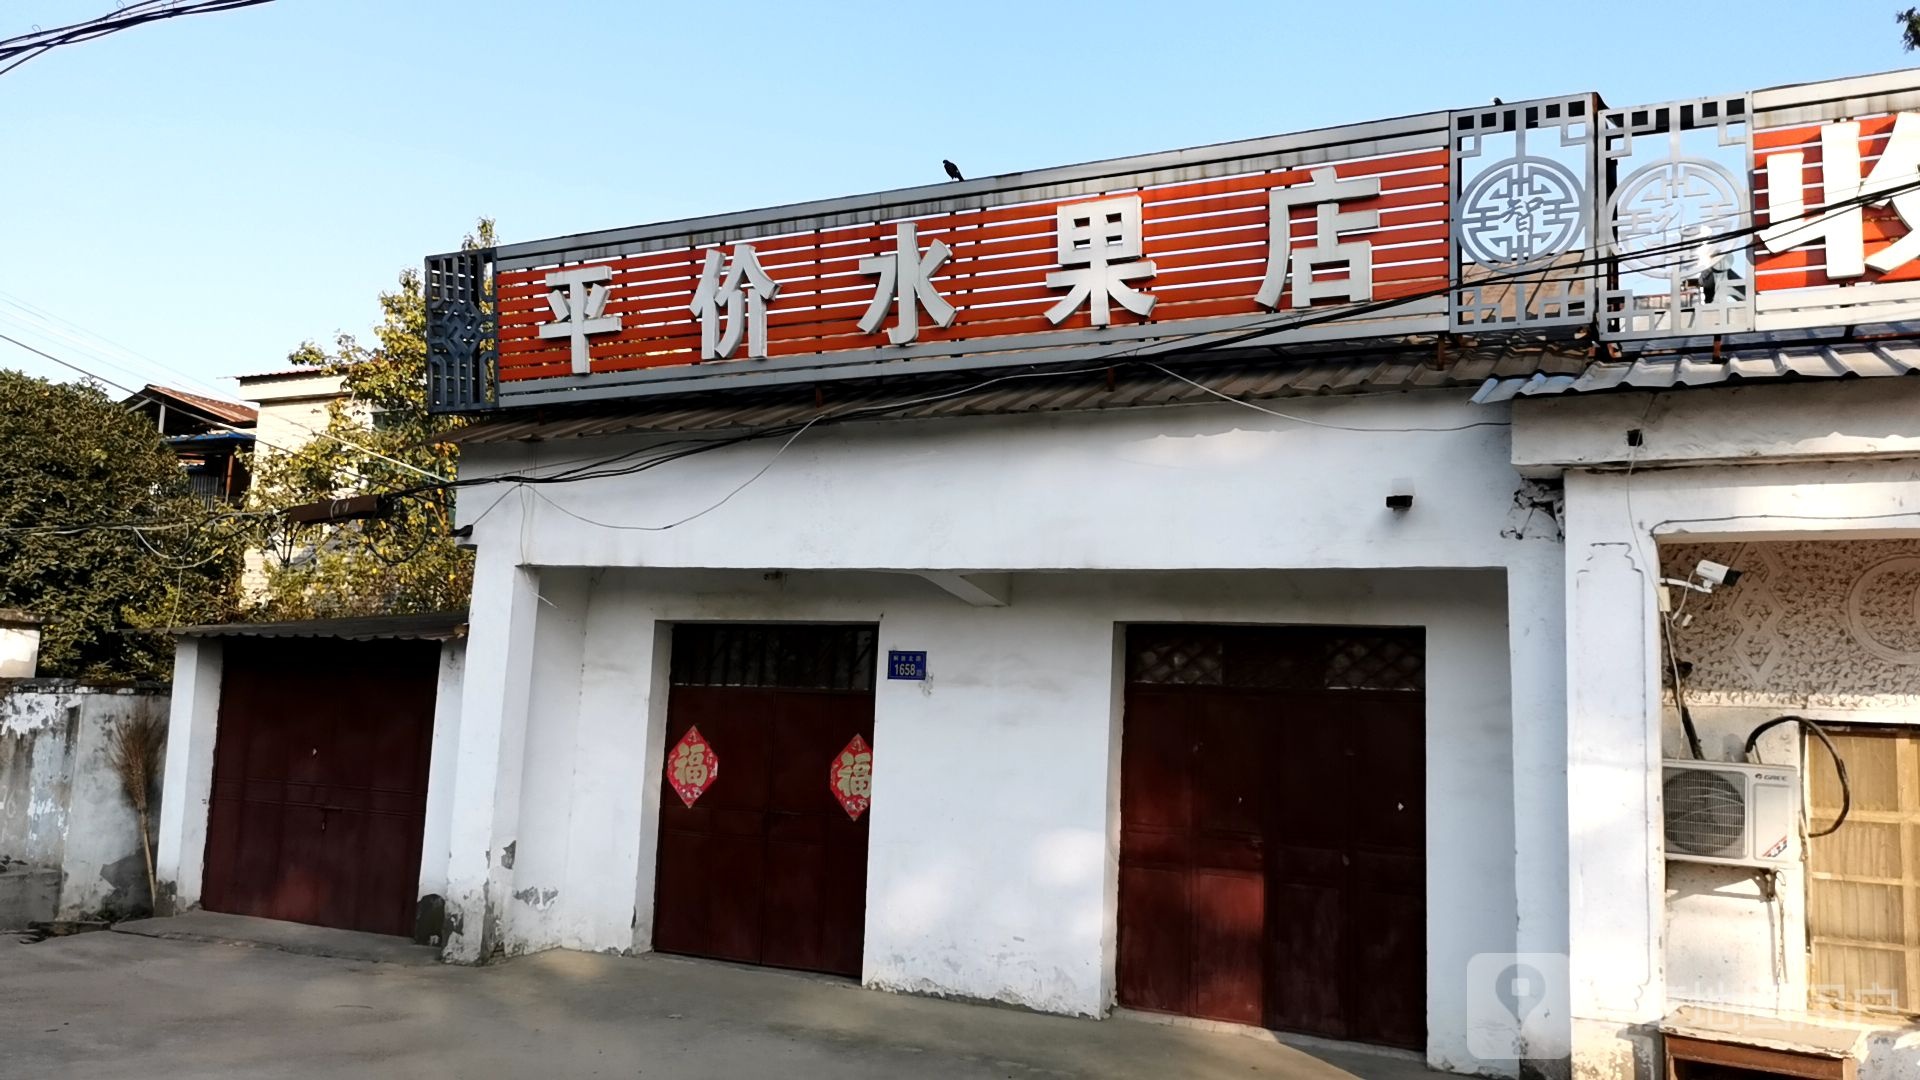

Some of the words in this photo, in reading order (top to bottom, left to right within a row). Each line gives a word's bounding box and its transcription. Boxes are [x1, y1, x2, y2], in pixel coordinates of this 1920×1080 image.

[1498, 197, 1545, 233] 智
[538, 166, 1381, 375] 平价水果店
[674, 742, 708, 787] 福
[837, 752, 872, 798] 福
